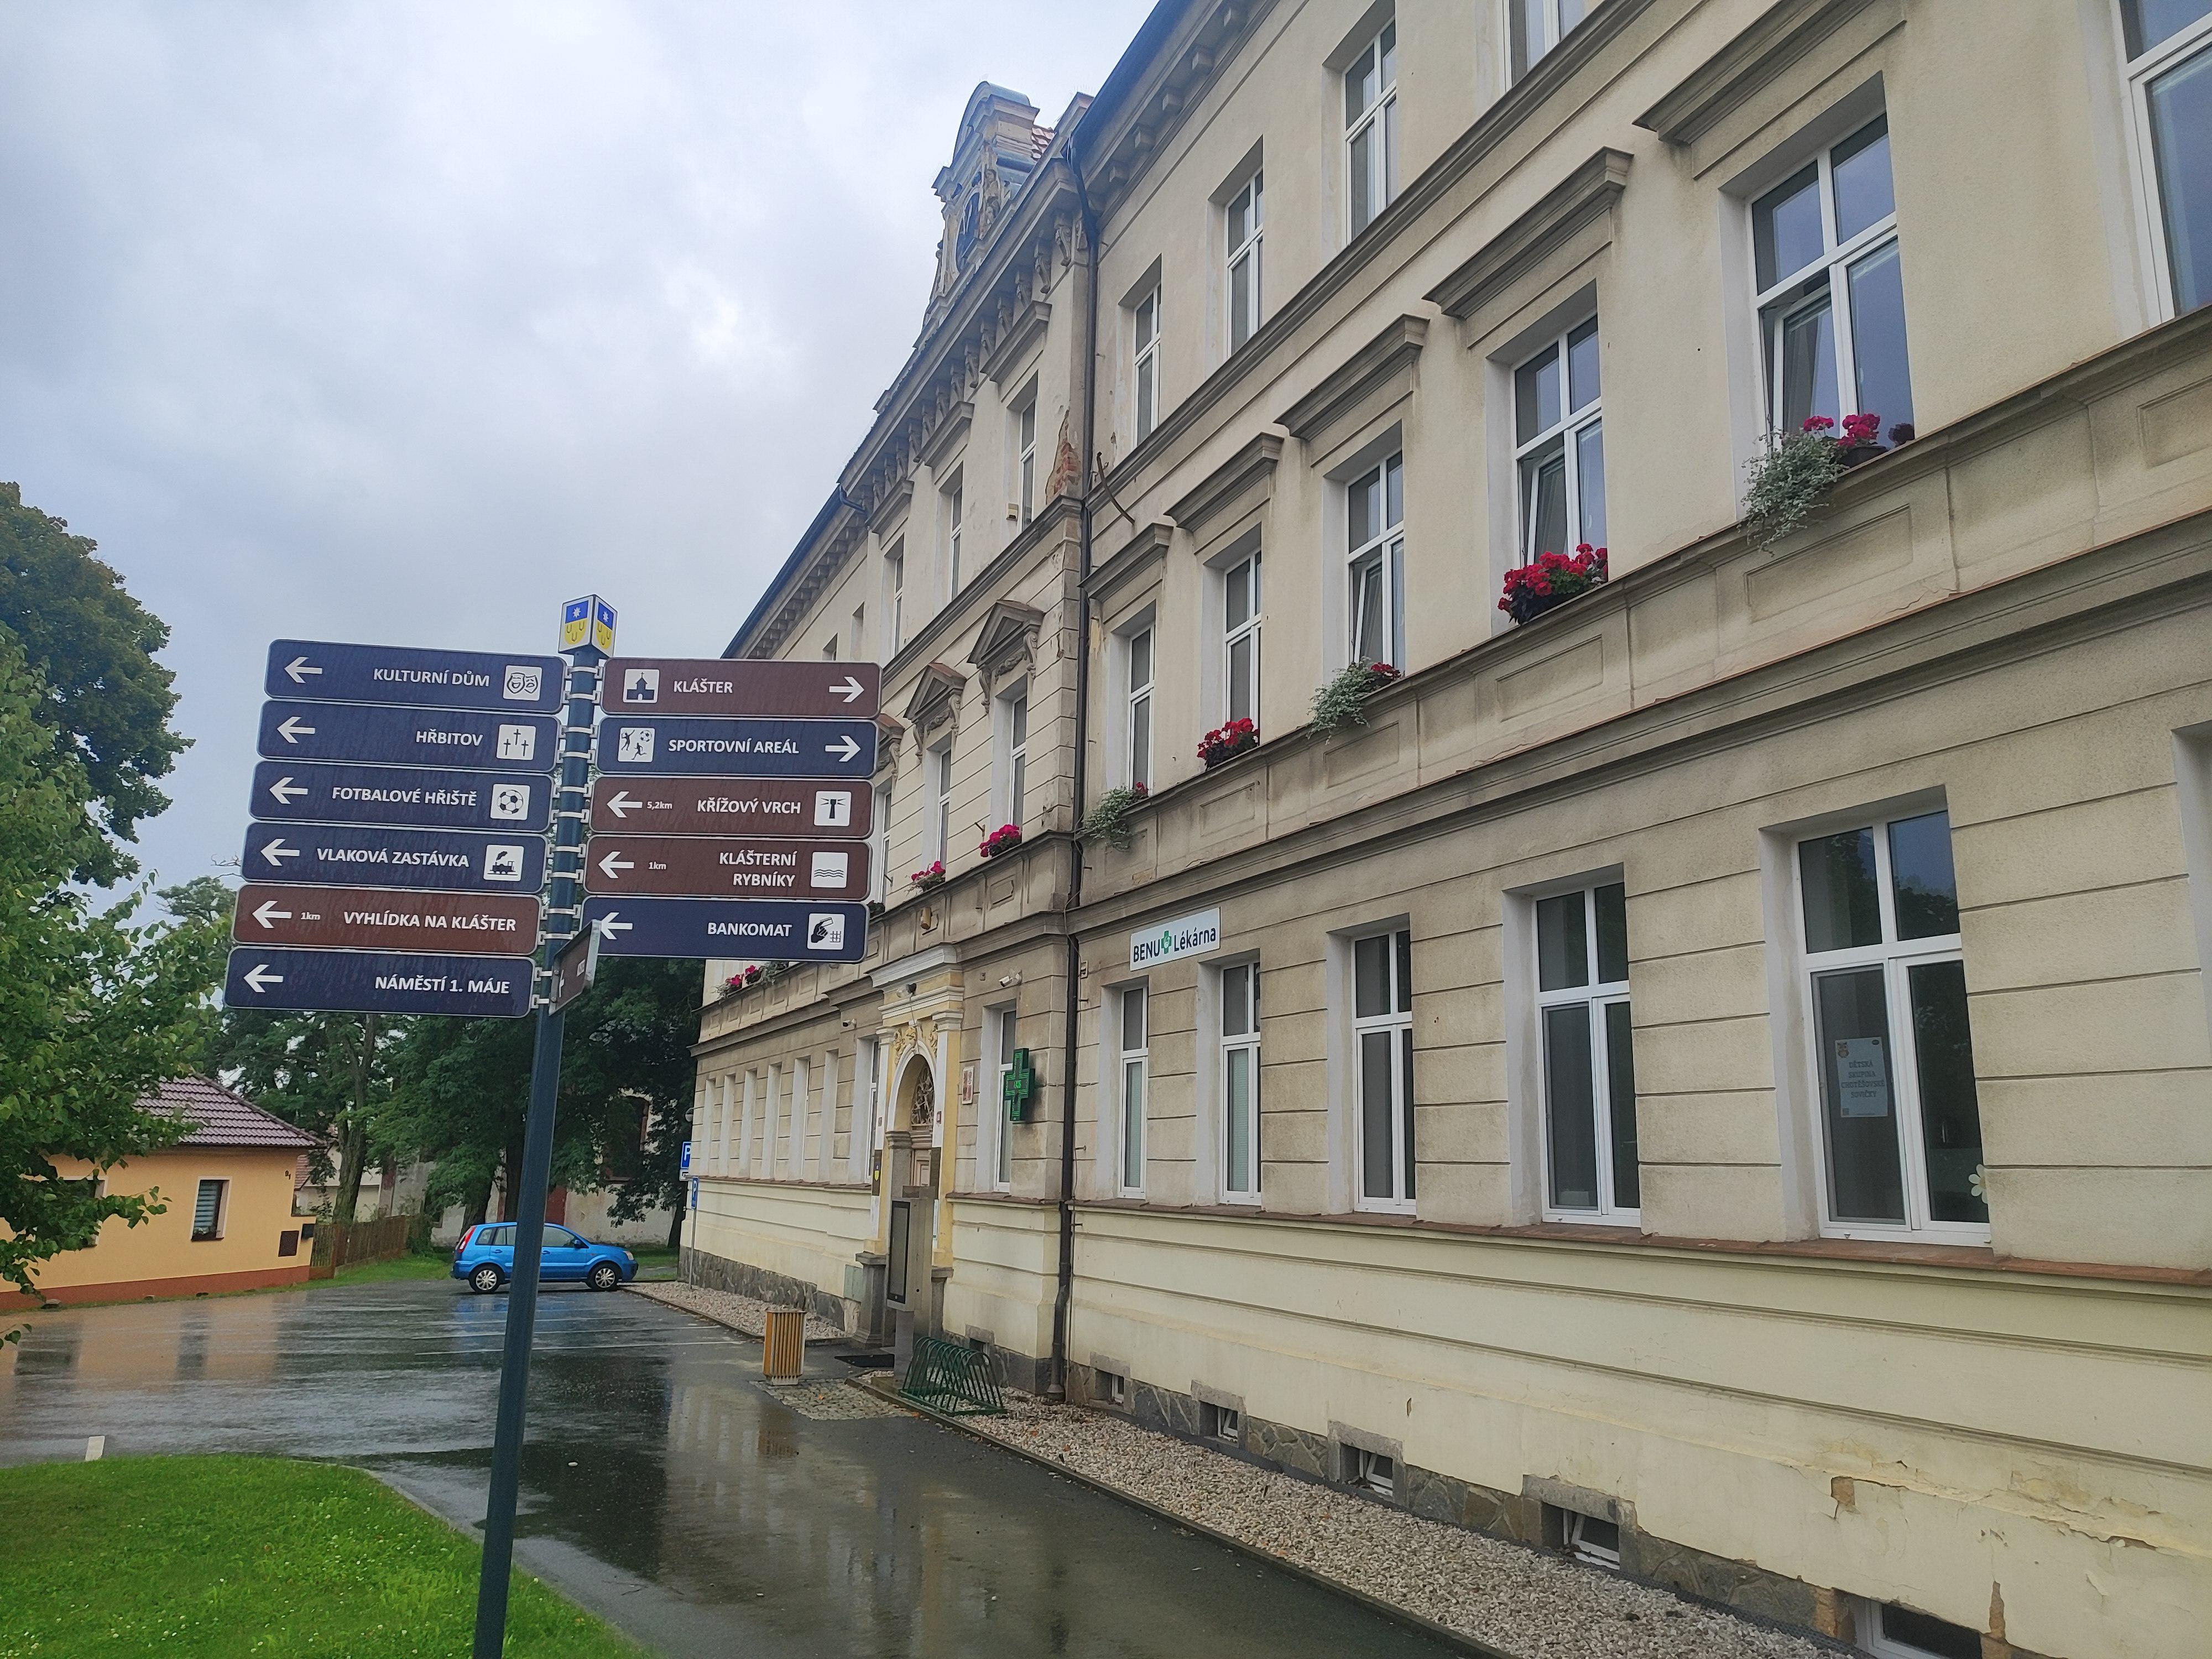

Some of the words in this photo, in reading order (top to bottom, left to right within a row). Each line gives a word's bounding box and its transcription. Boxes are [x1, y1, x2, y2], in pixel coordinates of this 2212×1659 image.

[373, 668, 450, 685] KULTURNÍ
[451, 669, 490, 687] DŮM
[673, 678, 733, 694] KLÁŠTER
[415, 728, 484, 747] HŘBITOV
[667, 738, 752, 753] SPORTOVNÍ
[753, 738, 800, 754] AREÁL
[331, 786, 422, 804] FOTBALOVÉ
[424, 789, 478, 807] HŘIŠTĚ
[696, 796, 760, 813] KŘÍŽOVÝ
[761, 801, 801, 815] VRCH
[646, 801, 673, 811] 5,2km
[316, 847, 389, 864] VLAKOVÁ
[391, 850, 470, 868] ZASTÁVKA
[648, 860, 667, 870] 1km
[719, 849, 797, 867] KLÁŠTERNÍ
[732, 871, 796, 887] RYBNÍKY
[300, 911, 321, 921] 1km
[343, 909, 421, 927] VYHLÍDKA
[424, 915, 448, 928] NA
[451, 914, 517, 932] KLÁŠTER
[707, 922, 793, 937] BANKOMAT
[1133, 938, 1161, 963] BENU
[1173, 926, 1217, 952] Lékárna
[374, 973, 448, 992] NÁMĚSTÍ
[450, 979, 463, 993] 1.
[467, 977, 510, 994] MÁJE
[684, 1145, 691, 1161] P
[692, 1180, 698, 1198] P
